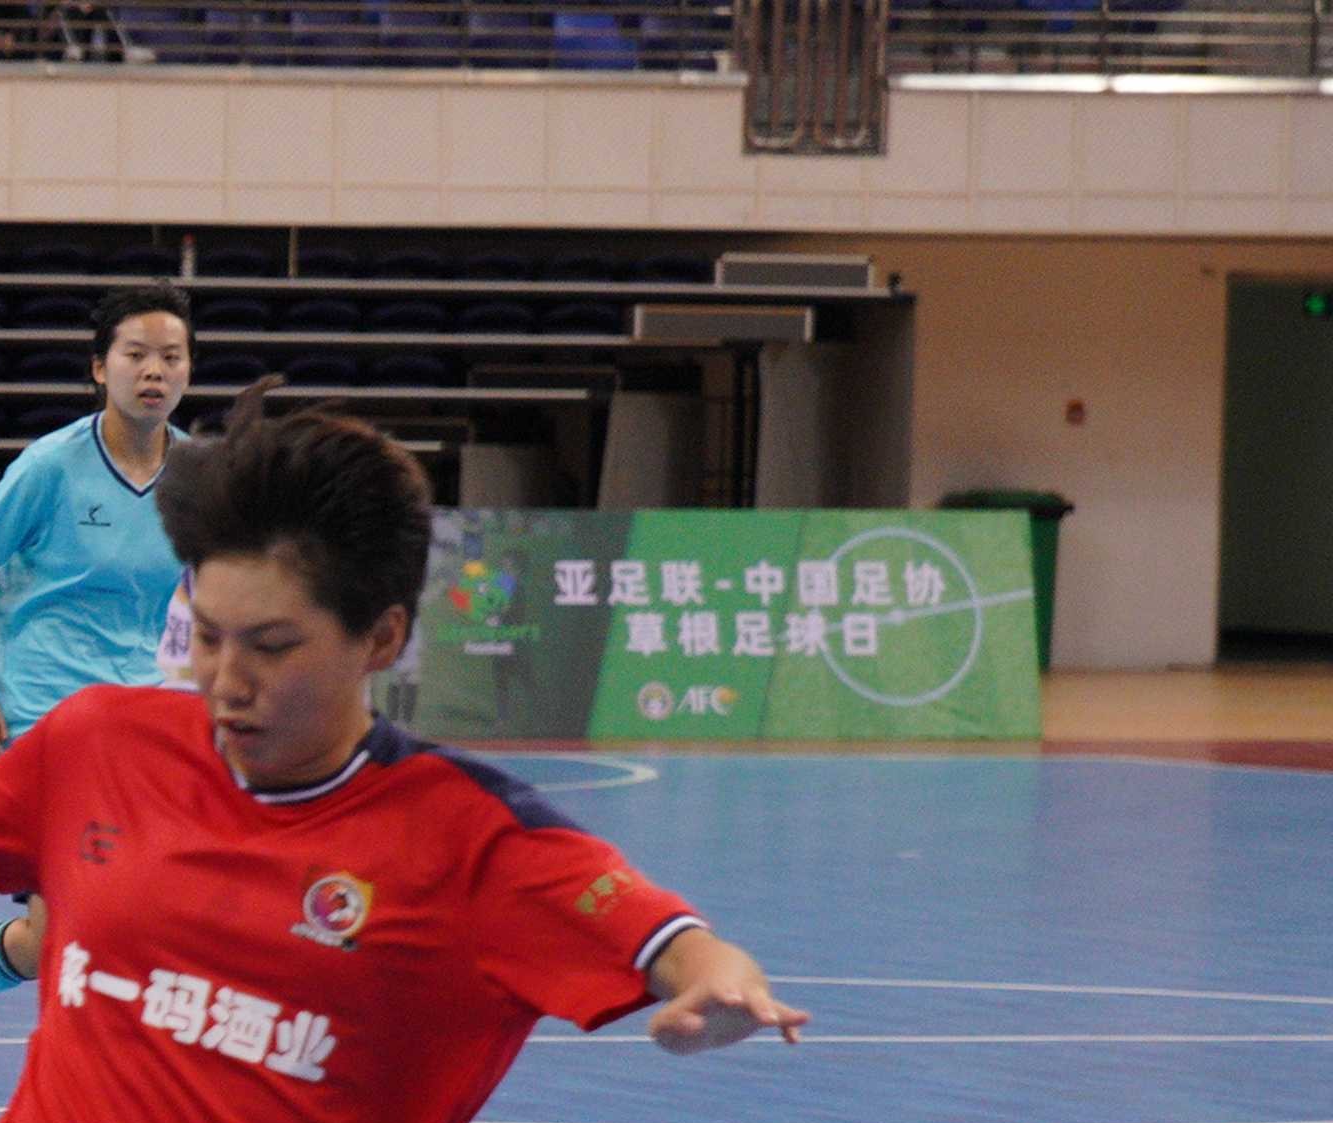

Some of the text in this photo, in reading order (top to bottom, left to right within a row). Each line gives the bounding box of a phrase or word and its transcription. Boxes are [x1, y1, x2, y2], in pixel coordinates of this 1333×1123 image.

[626, 612, 879, 657] 草根足球日
